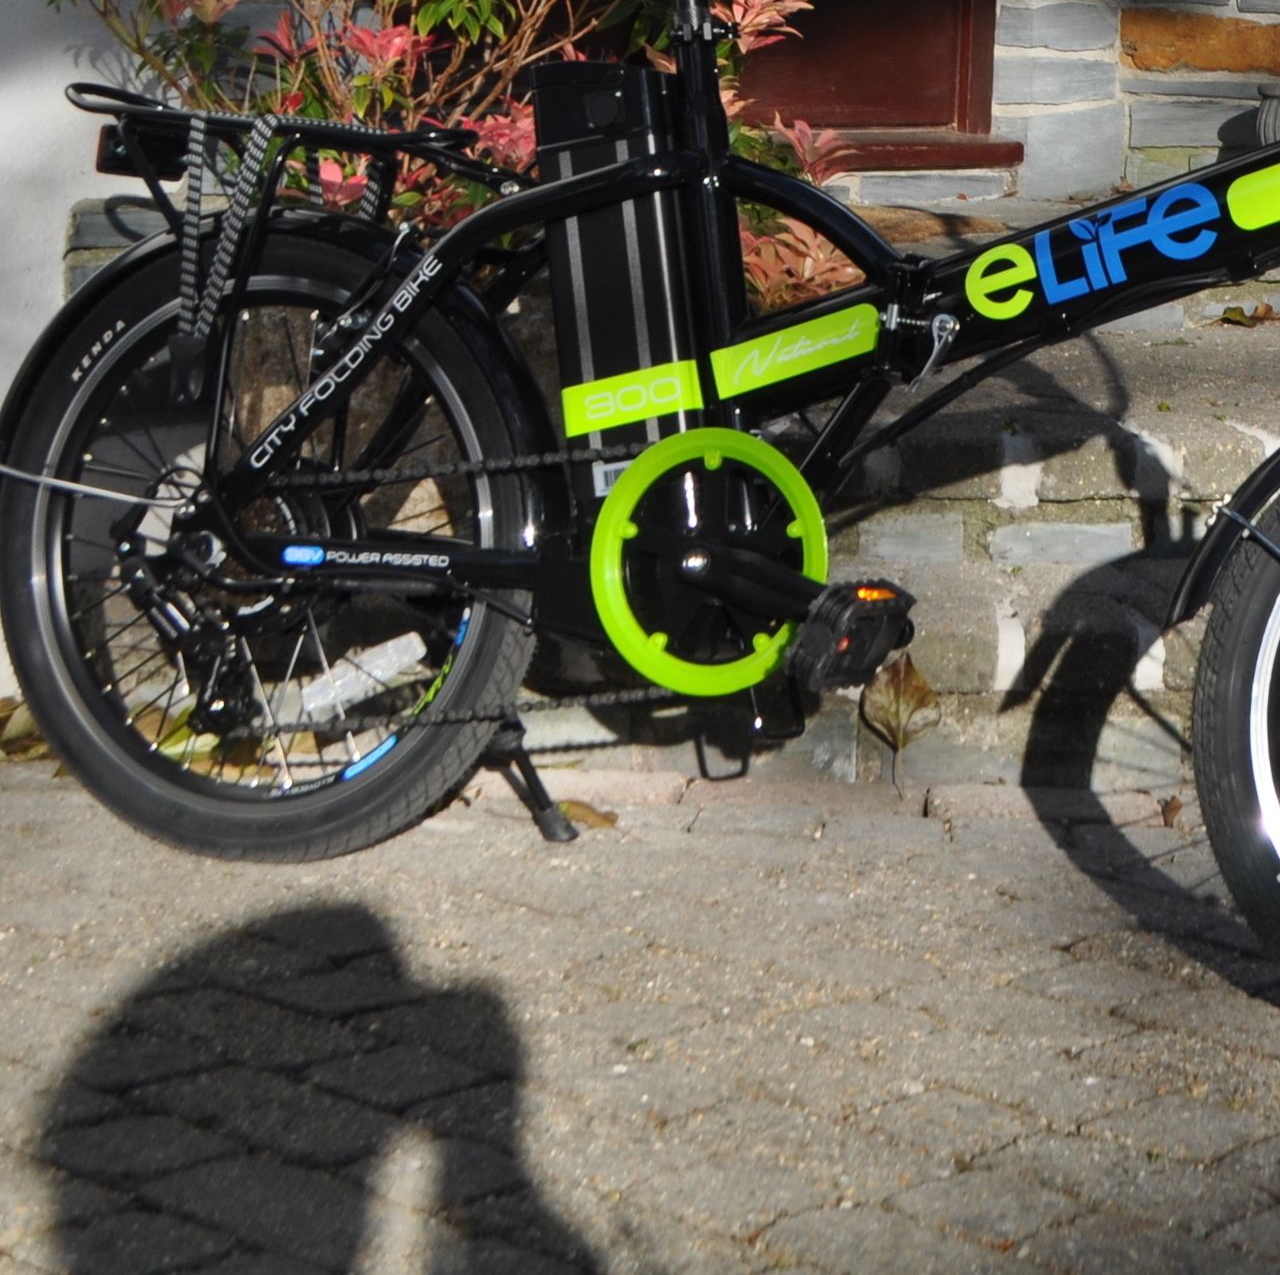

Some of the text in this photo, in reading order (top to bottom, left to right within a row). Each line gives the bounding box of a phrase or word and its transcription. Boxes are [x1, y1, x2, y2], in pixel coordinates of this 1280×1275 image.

[71, 320, 126, 382] KENDA
[250, 255, 443, 468] CITY FOLDING BIKE
[584, 376, 682, 420] 300
[326, 551, 380, 564] POWER
[382, 553, 450, 567] ASSISTED
